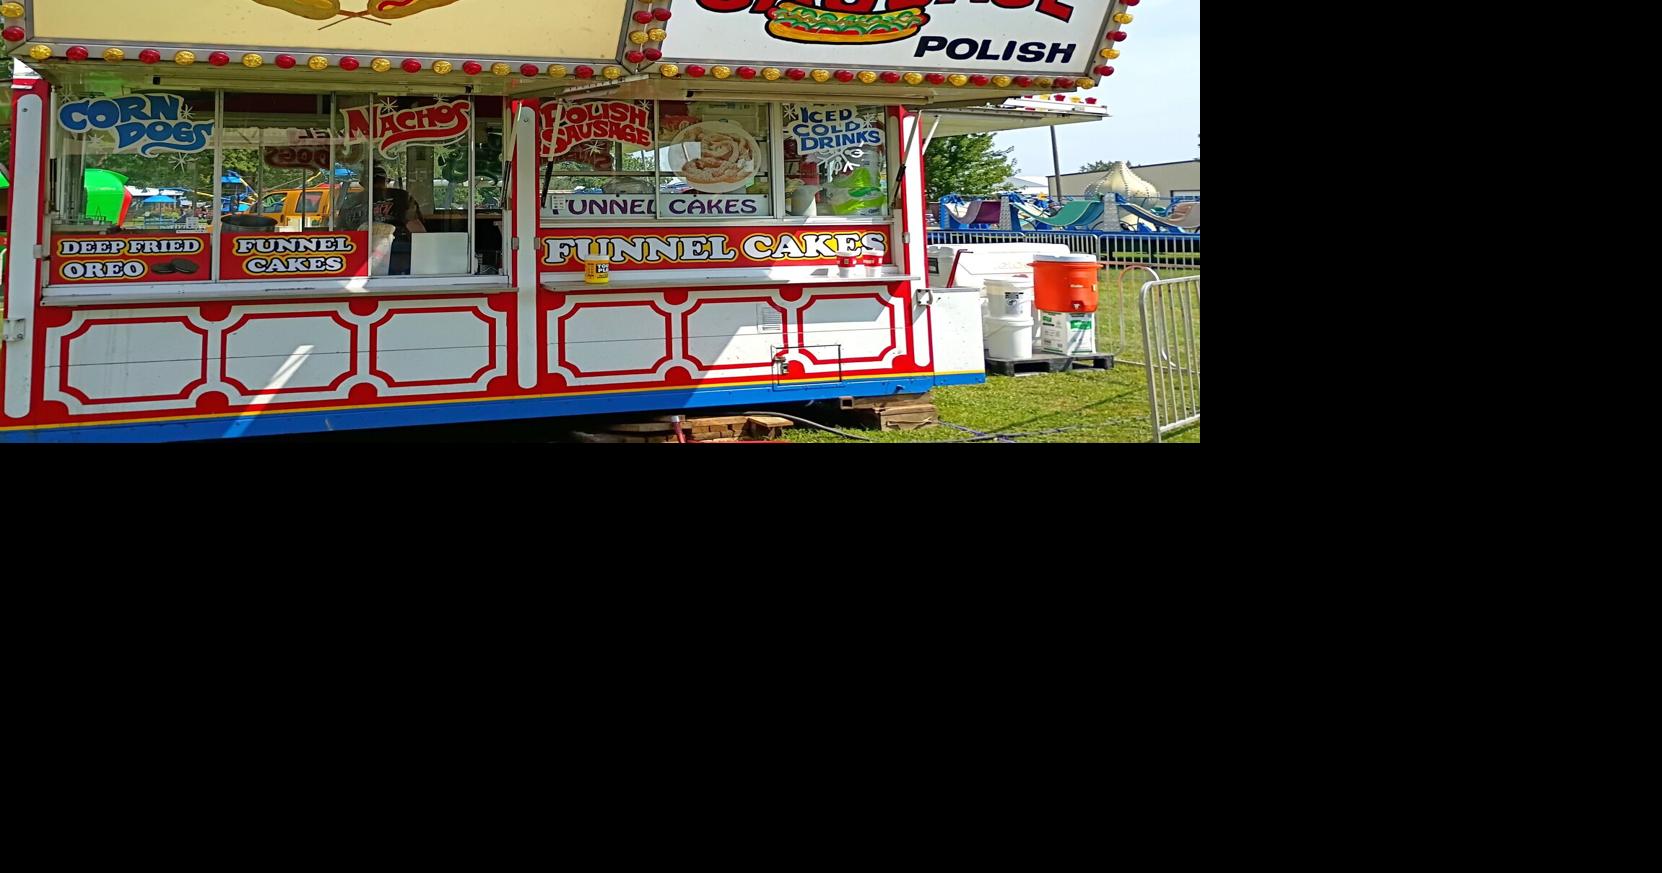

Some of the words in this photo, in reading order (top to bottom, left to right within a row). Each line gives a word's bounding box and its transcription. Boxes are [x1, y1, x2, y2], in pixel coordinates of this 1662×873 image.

[913, 36, 1076, 64] POLISH
[58, 96, 182, 132] CORN
[542, 102, 648, 126] POLISH
[799, 106, 852, 124] ICED
[342, 102, 470, 151] NACHOS
[793, 122, 859, 138] COLD
[115, 121, 214, 155] DOGS
[542, 121, 651, 154] SAUSAGE
[801, 131, 881, 151] DRINKS
[552, 198, 654, 215] UNNEL
[669, 198, 757, 214] CAKES
[61, 240, 125, 254] DEEP
[128, 238, 201, 254] FRIED
[236, 237, 353, 253] FUNNEL
[543, 235, 736, 263] FUNNEL
[743, 234, 885, 260] CAKES
[62, 262, 145, 278] OREO
[246, 257, 344, 272] CAKES
